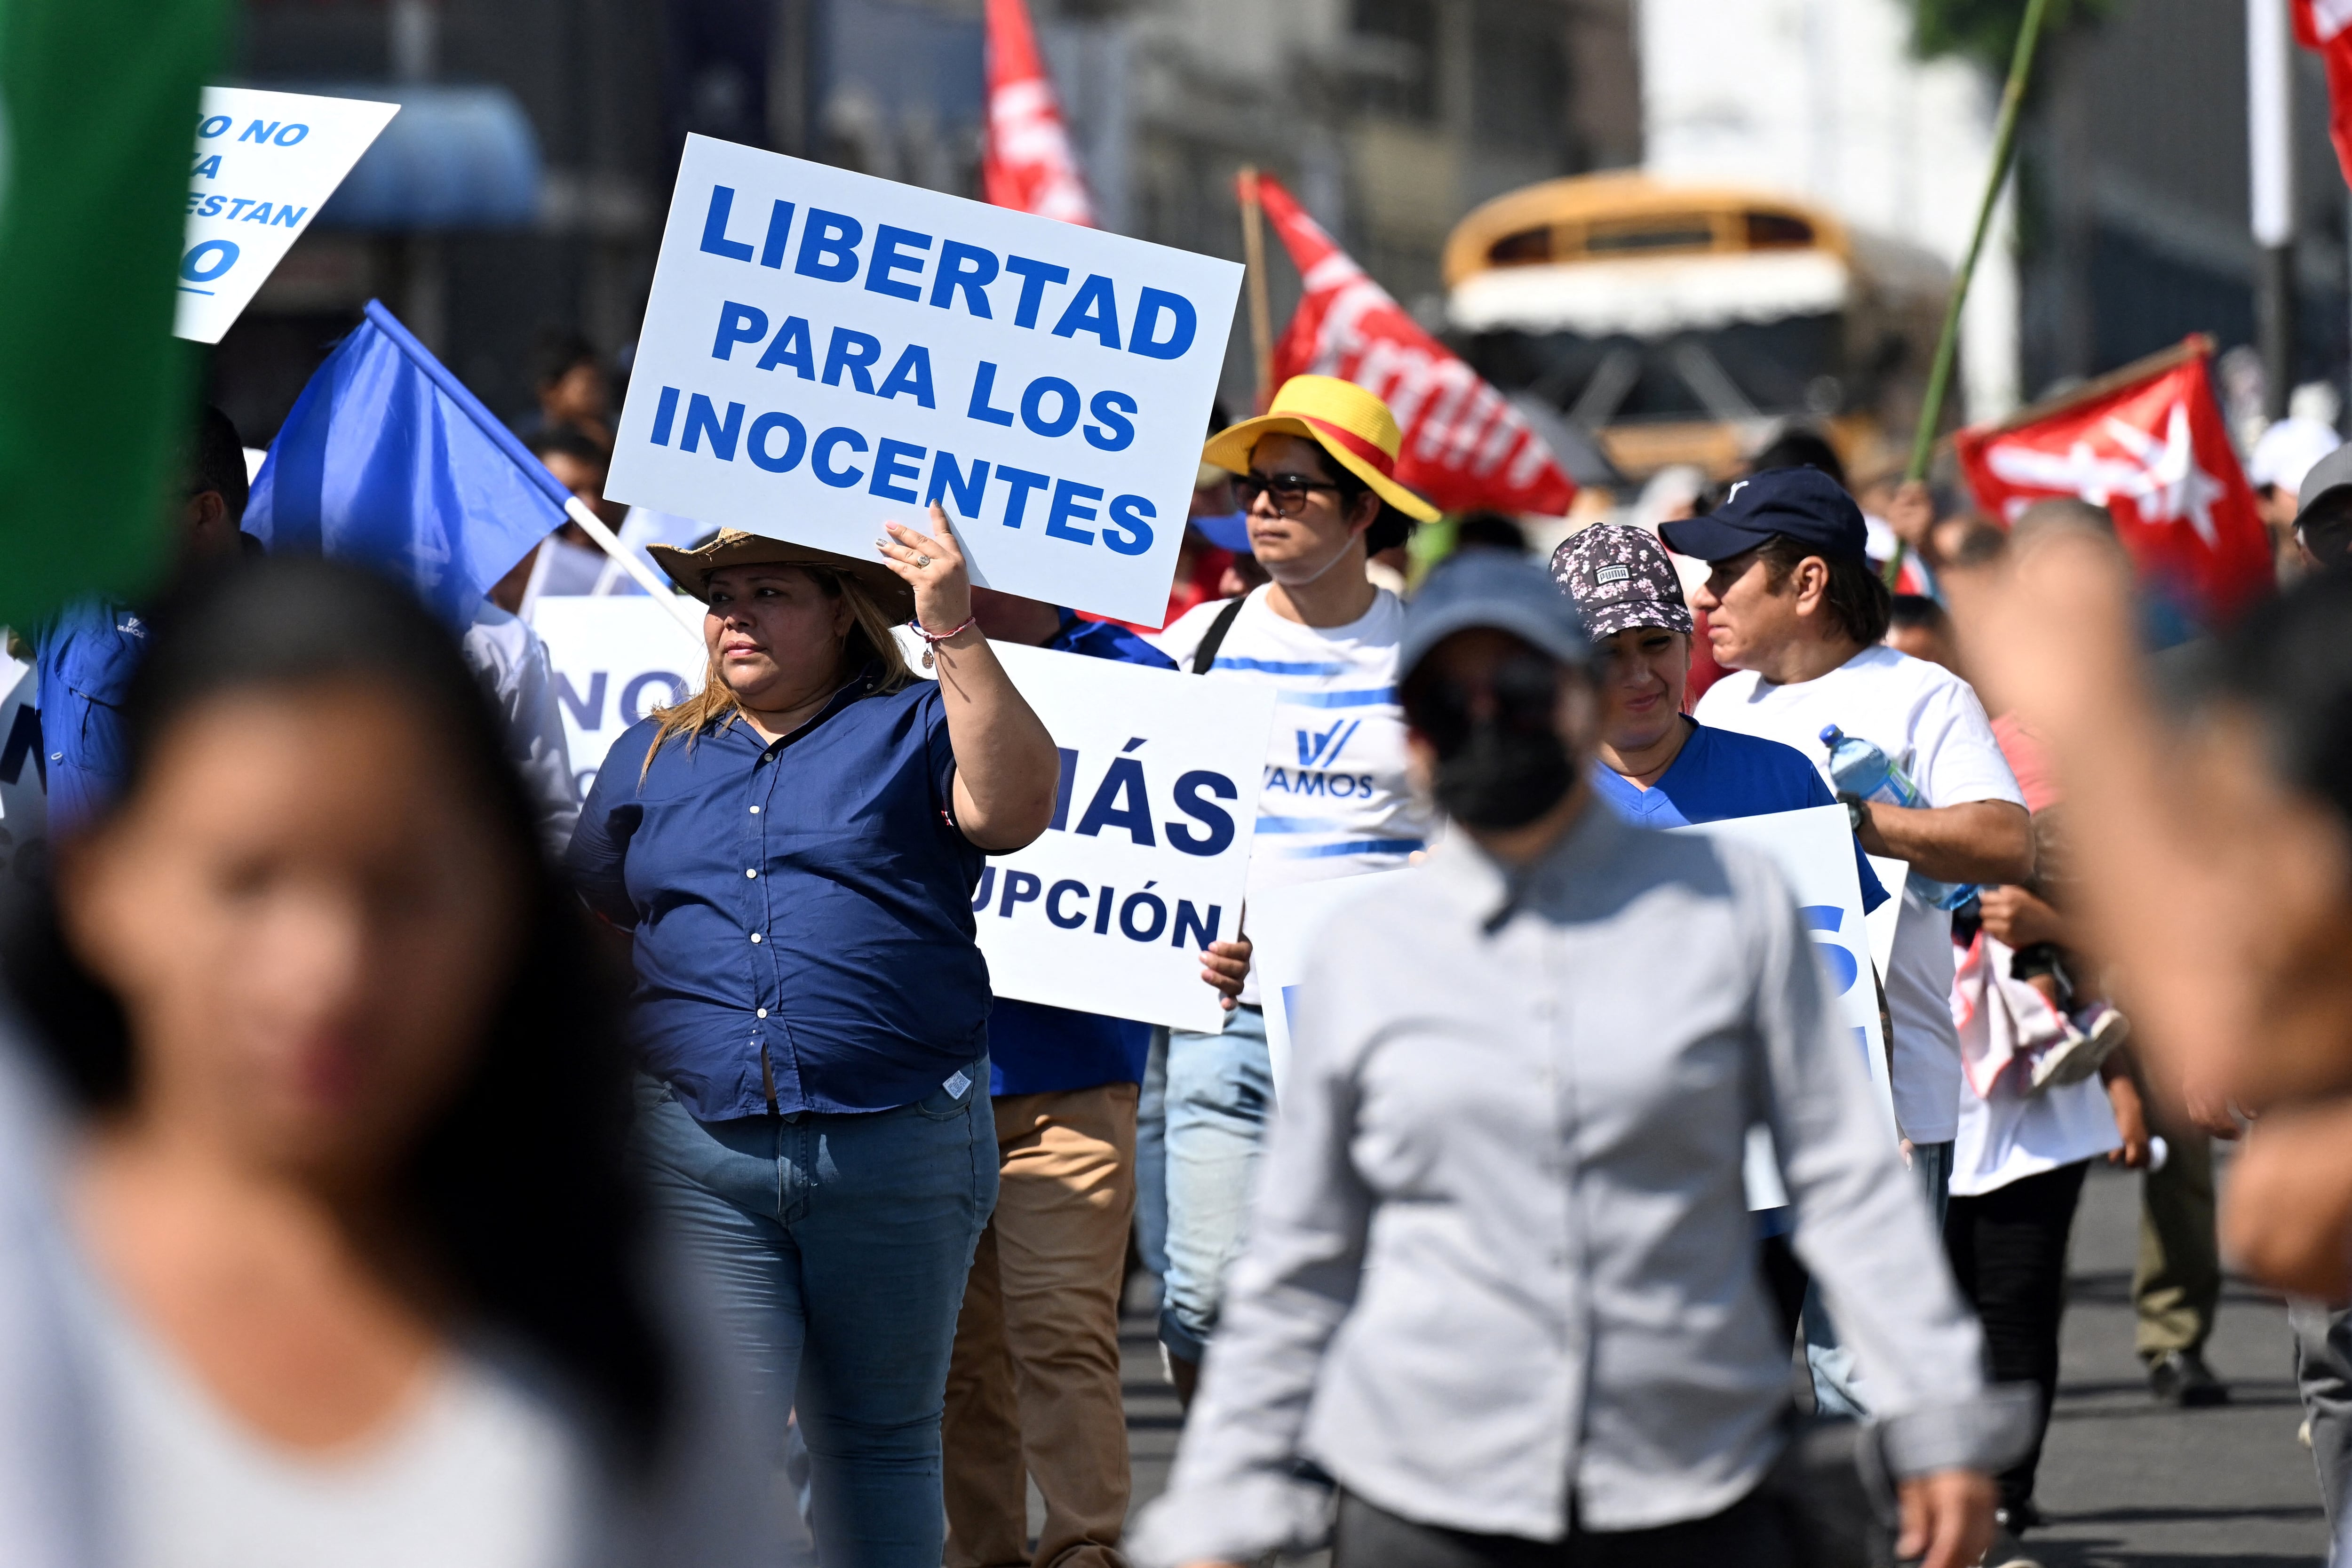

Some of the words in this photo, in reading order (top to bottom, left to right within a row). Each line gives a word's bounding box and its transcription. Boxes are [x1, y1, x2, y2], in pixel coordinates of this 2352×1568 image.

[238, 119, 310, 147] NO
[699, 185, 1197, 360] LIBERTAD
[712, 301, 936, 410] PARA
[967, 360, 1138, 452] LOS
[650, 386, 1157, 556] INOCENTES
[1600, 569, 1627, 581] PUMA
[1047, 737, 1238, 857] ÁS
[1264, 766, 1373, 798] AMOS
